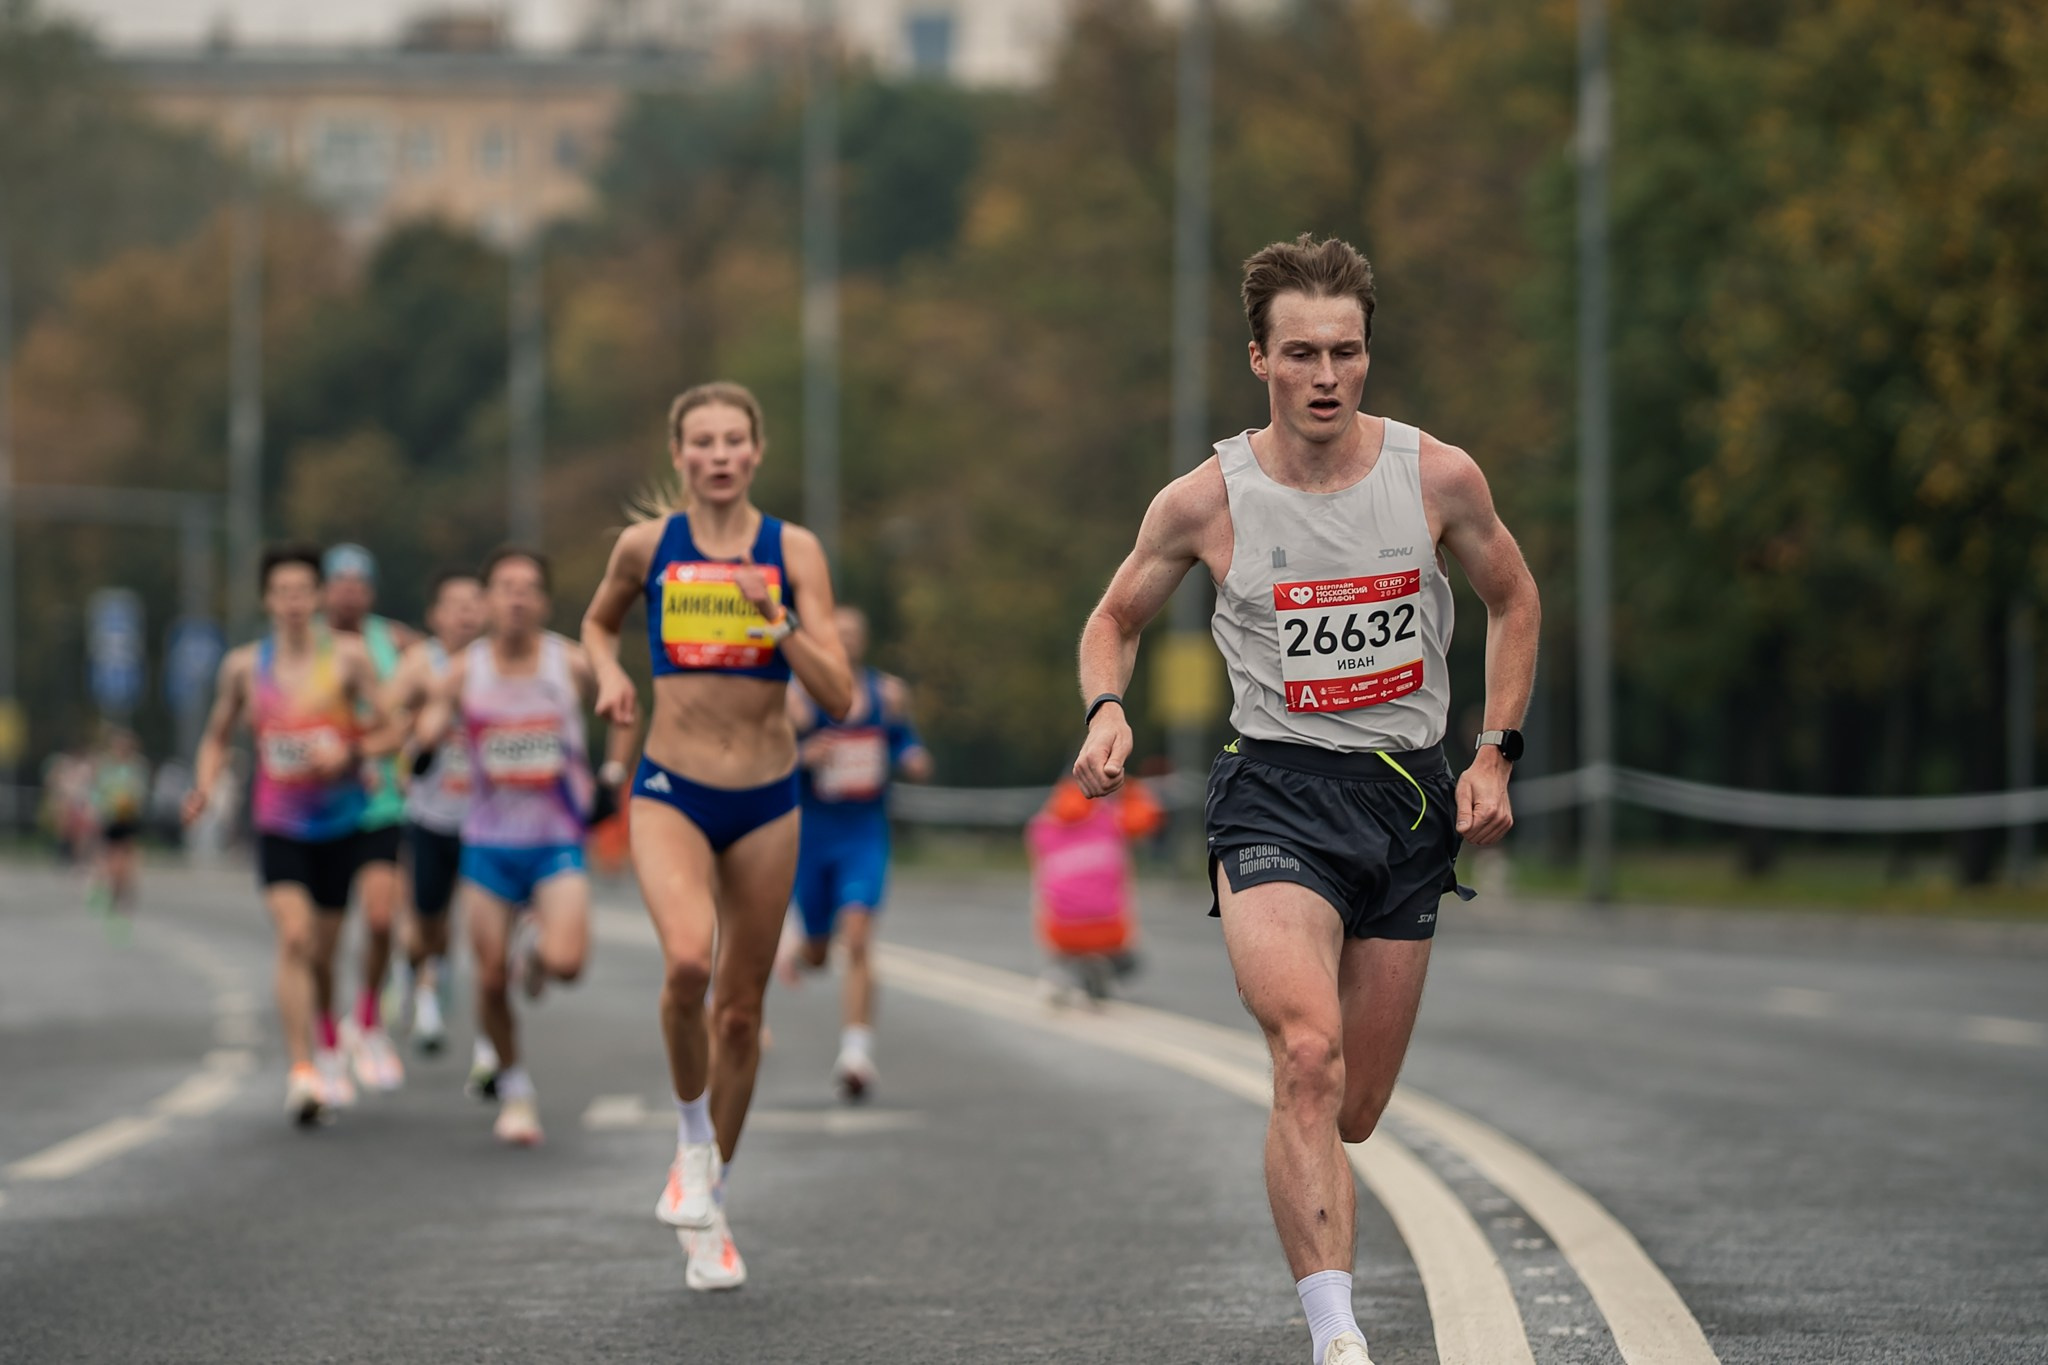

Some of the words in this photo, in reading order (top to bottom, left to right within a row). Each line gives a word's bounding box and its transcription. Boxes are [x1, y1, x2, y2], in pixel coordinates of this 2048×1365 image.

[1378, 546, 1413, 558] SONU
[1316, 582, 1354, 591] СБЕРПРАЙМ
[1378, 580, 1388, 588] 10
[1389, 578, 1402, 587] КМ
[1316, 586, 1367, 598] МОСКОВСКИЙ
[1316, 594, 1355, 604] МАРАФОН
[1284, 603, 1416, 657] 26632
[1337, 655, 1375, 670] ИВАН
[1239, 856, 1300, 876] МОНАСТЫРЬ
